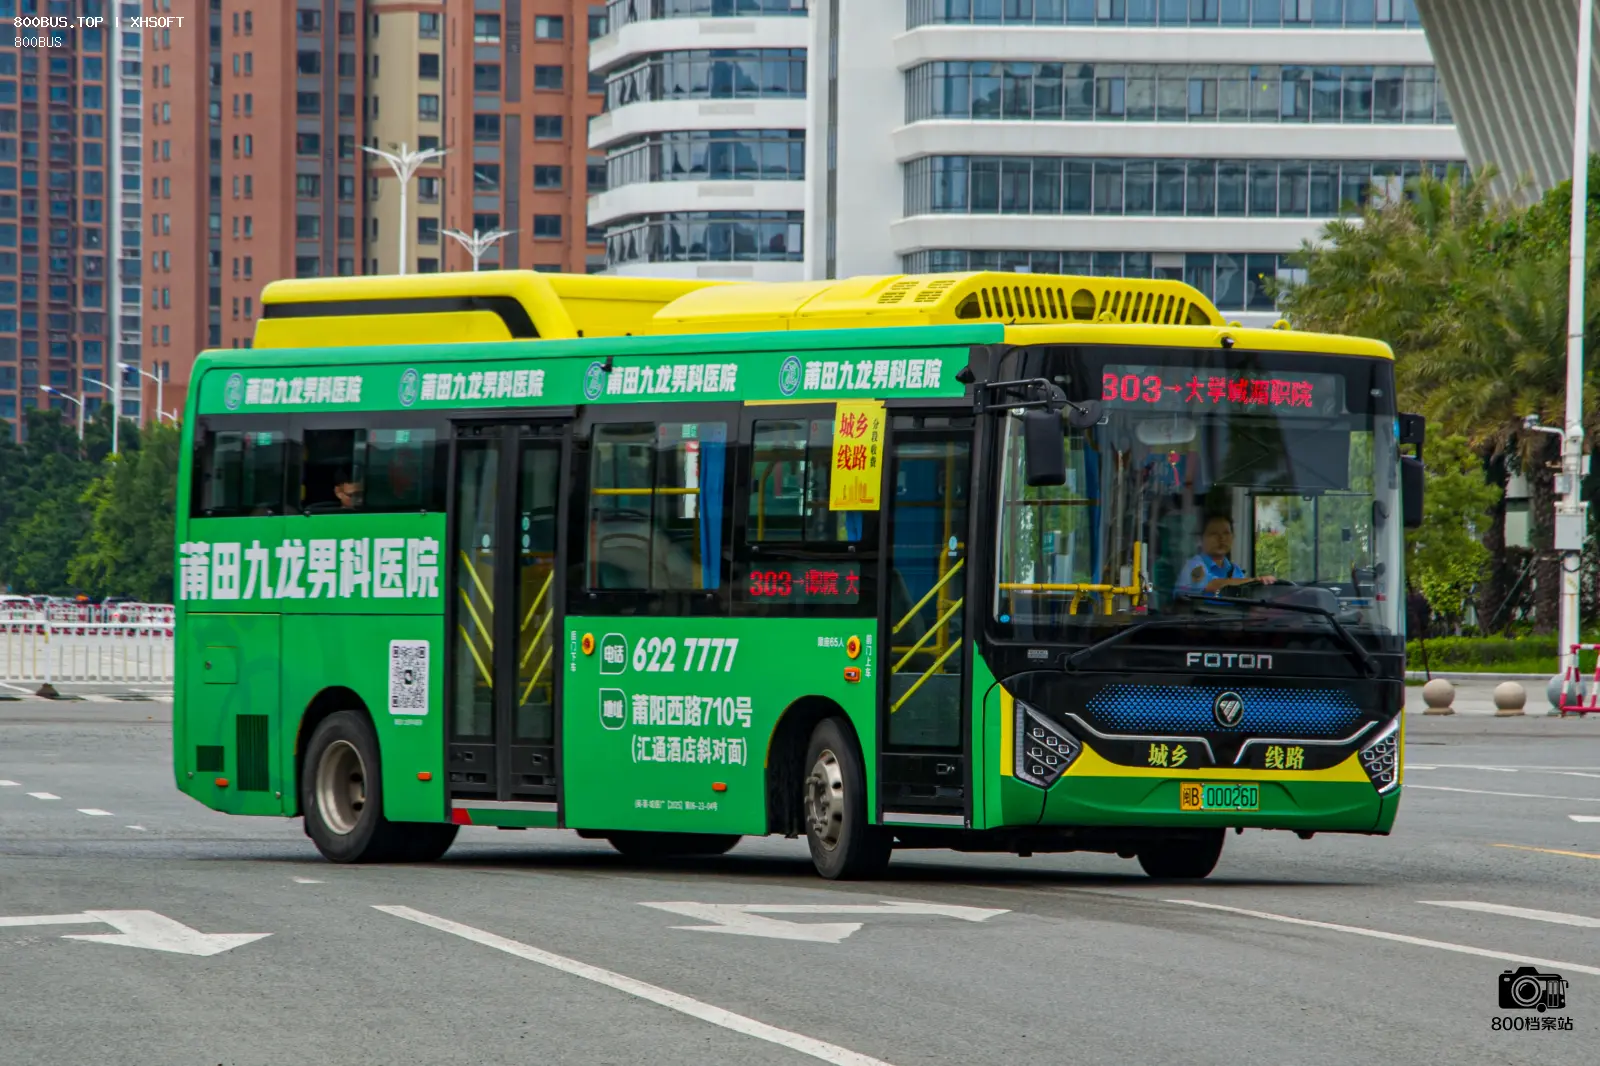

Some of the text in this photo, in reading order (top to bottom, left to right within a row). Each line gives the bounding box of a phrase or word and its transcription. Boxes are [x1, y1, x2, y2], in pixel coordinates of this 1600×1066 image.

[420, 369, 545, 401] 莆田九龙男科医院
[606, 363, 738, 395] 莆田九龙男科医院
[803, 358, 943, 390] 莆田九龙男科医院
[1102, 373, 1162, 403] 303
[245, 375, 363, 405] 莆田九龙男科医院
[839, 412, 869, 439] 城乡
[837, 444, 867, 471] 线路
[179, 536, 439, 601] 莆田九龙男科医院
[749, 570, 792, 597] 303
[603, 645, 624, 664] 电话
[632, 636, 739, 672] 622 7777
[1186, 652, 1273, 669] FOTON
[631, 694, 753, 728] 莆阳西路710号
[1148, 743, 1305, 770] 城乡 线路
[1207, 787, 1258, 807] 00026D
